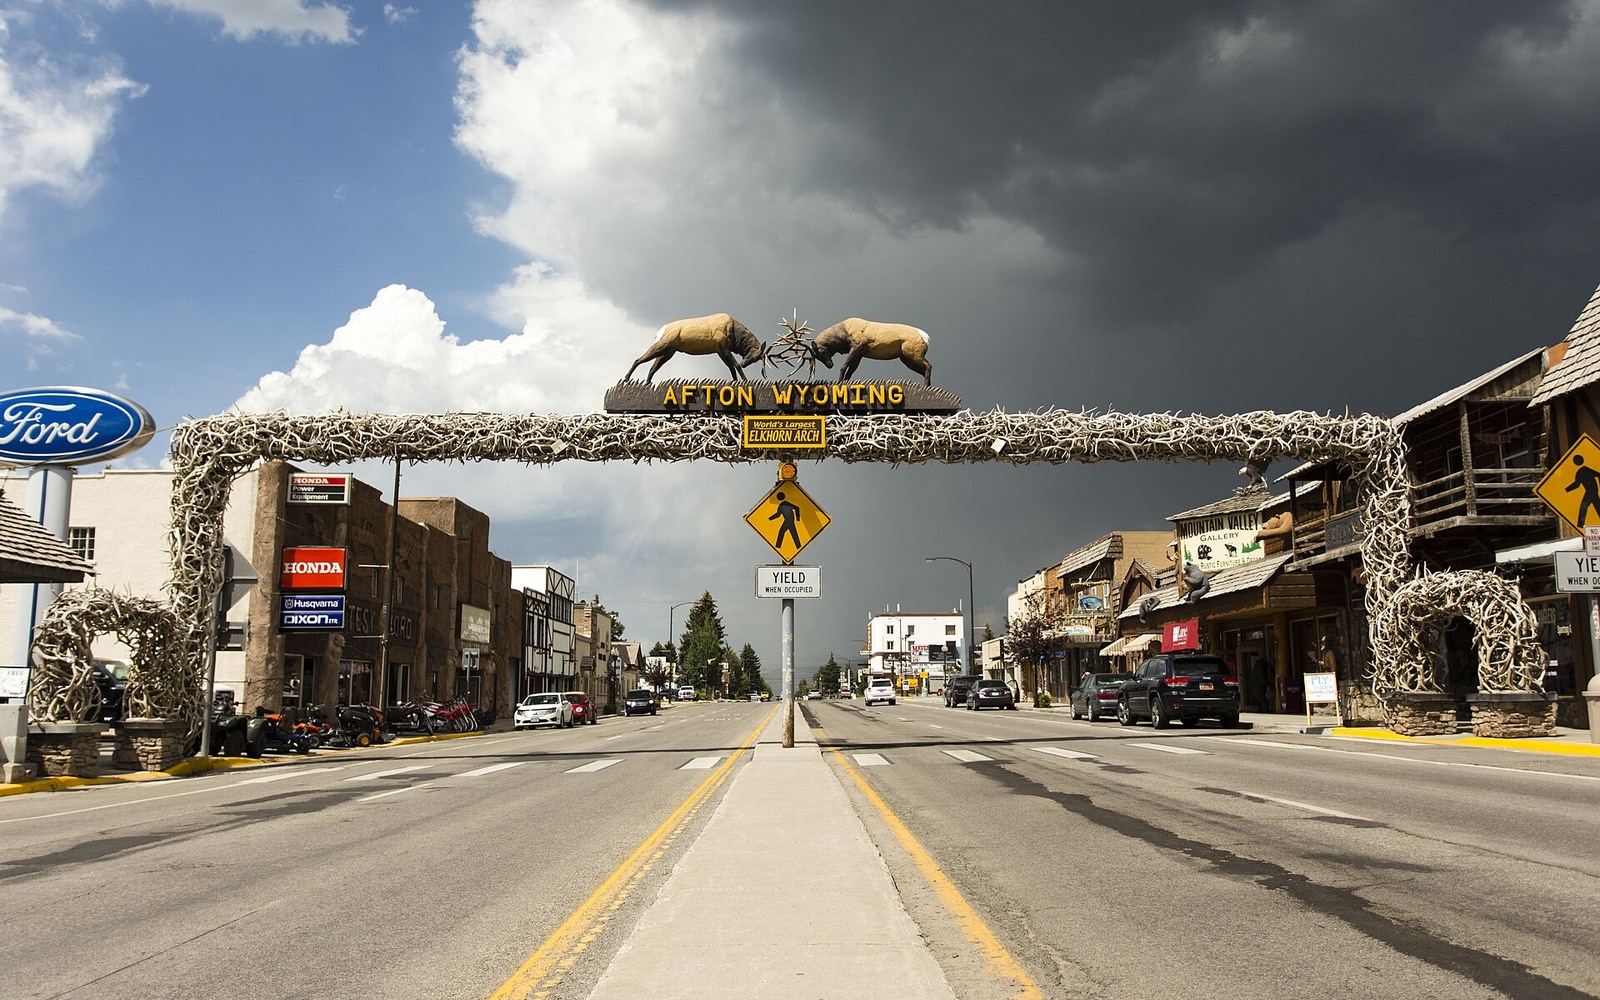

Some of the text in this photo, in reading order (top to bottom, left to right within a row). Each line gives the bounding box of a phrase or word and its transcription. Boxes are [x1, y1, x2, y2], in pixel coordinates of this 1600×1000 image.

[663, 384, 904, 406] AFTON WYOMING
[0, 402, 103, 444] Ford
[785, 421, 816, 429] Largest
[749, 430, 820, 442] ELKHORN ARCH
[1180, 513, 1260, 540] MOUNTAIN VALLEY
[283, 562, 343, 574] HONDA
[1575, 558, 1600, 573] YIE
[772, 572, 806, 584] YIELD
[1567, 576, 1589, 585] WHEN
[294, 599, 339, 609] Husqvarna
